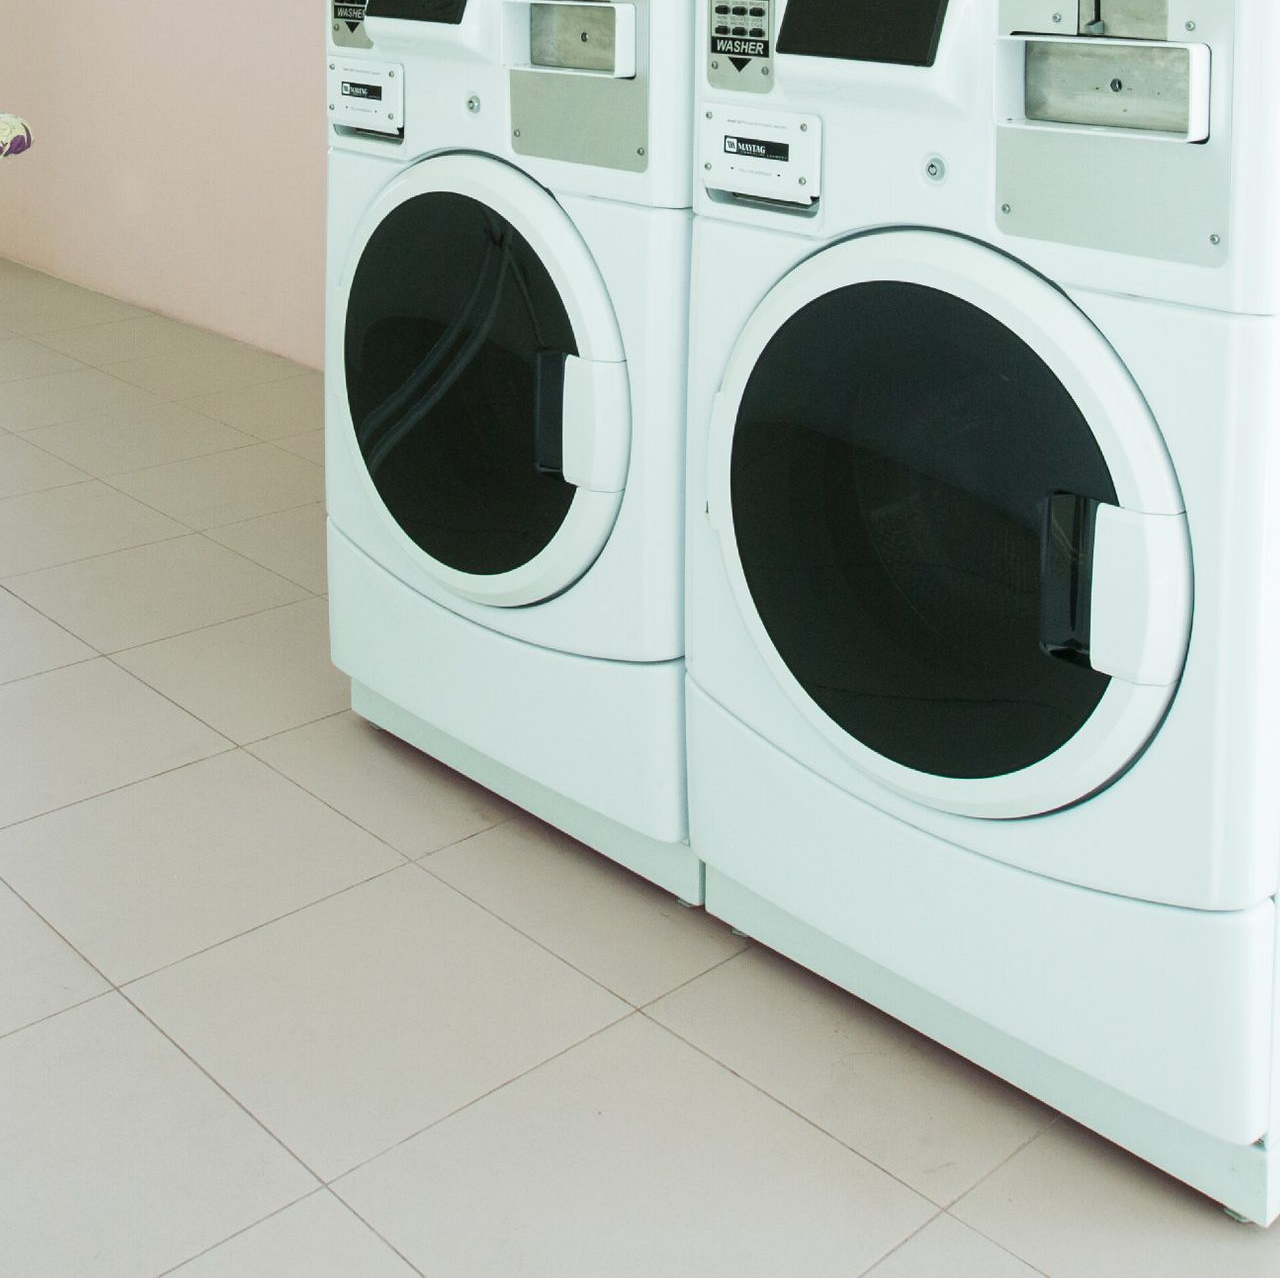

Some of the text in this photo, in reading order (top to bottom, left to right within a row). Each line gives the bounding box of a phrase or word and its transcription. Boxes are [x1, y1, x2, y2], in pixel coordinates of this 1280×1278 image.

[337, 7, 365, 19] WASHE
[716, 39, 764, 54] WASHER
[738, 142, 766, 154] MAYTAG
